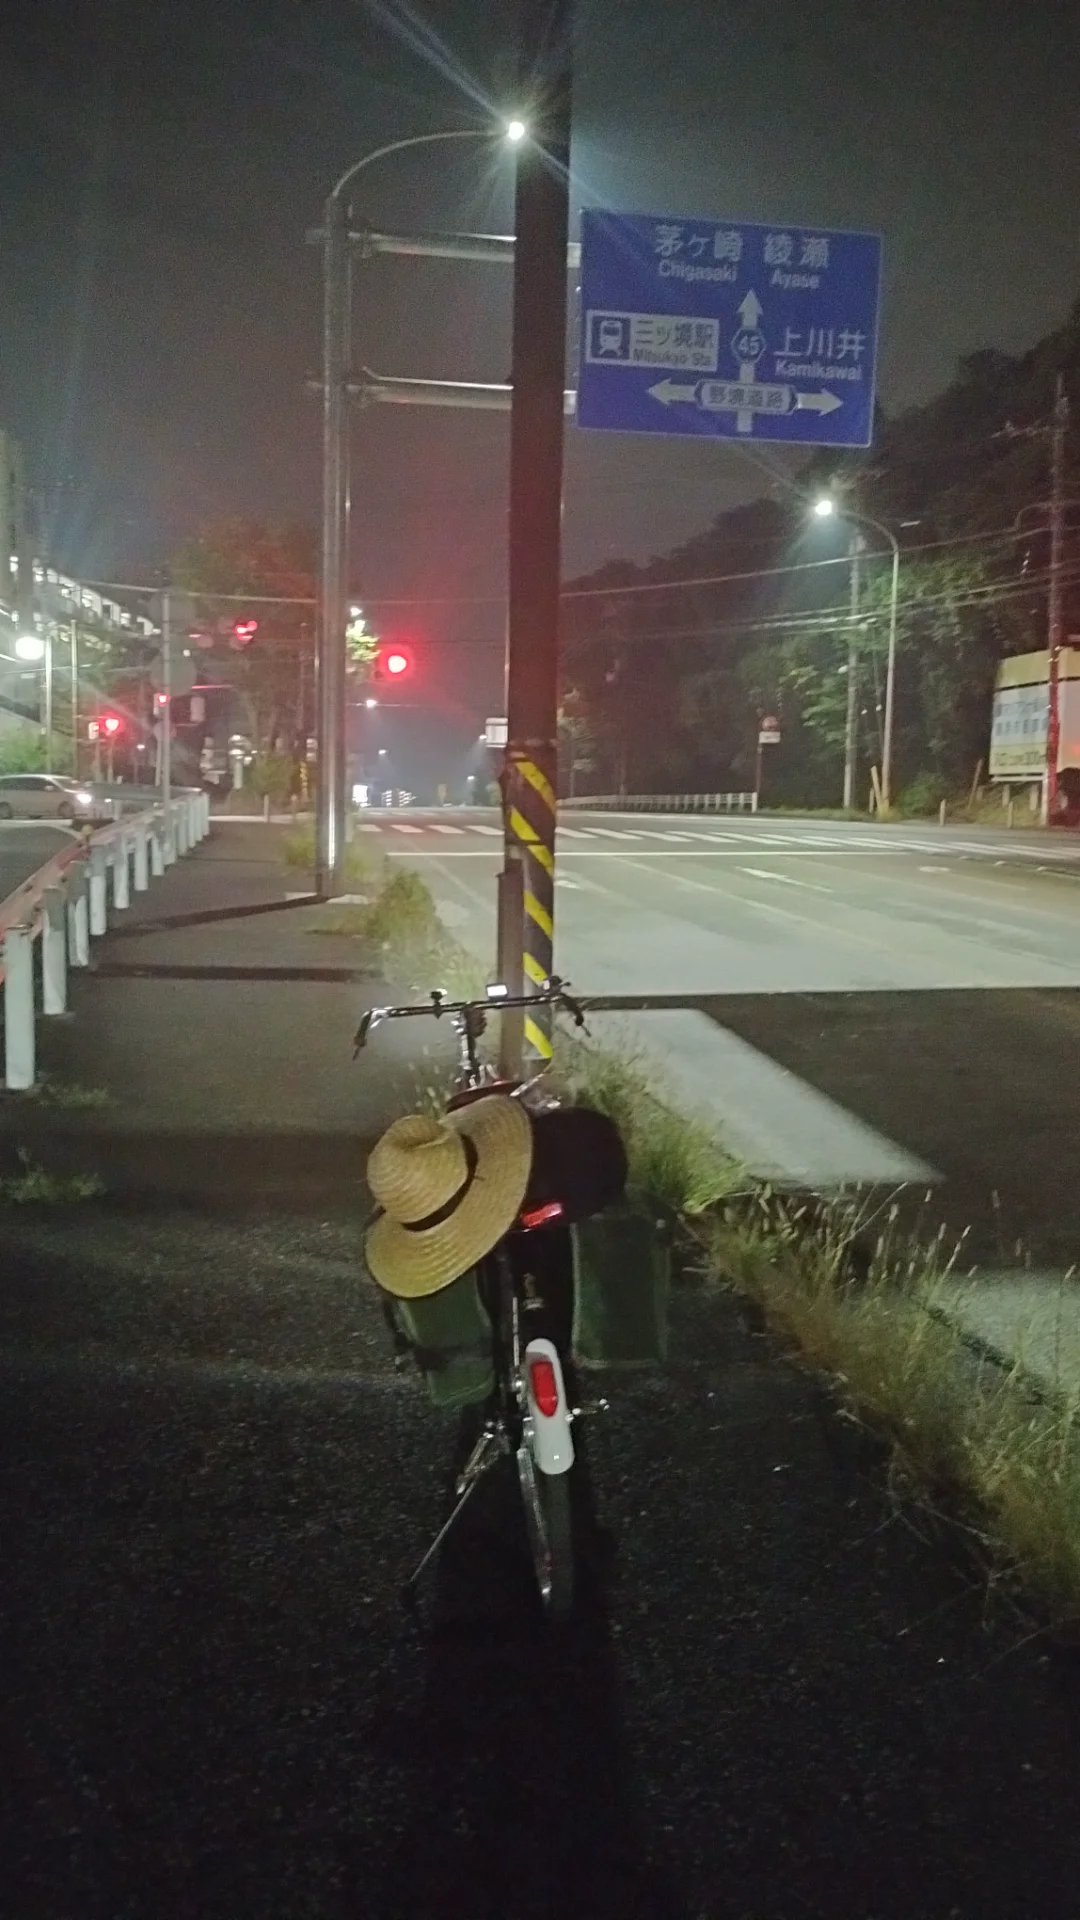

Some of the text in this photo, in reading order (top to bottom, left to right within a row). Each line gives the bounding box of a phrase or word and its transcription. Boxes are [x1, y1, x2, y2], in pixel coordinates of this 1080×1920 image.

[659, 259, 737, 282] Chigasaki
[772, 268, 821, 289] Ayase
[738, 335, 760, 356] 45
[773, 326, 866, 361] 上川井
[775, 359, 862, 381] Kamikawai
